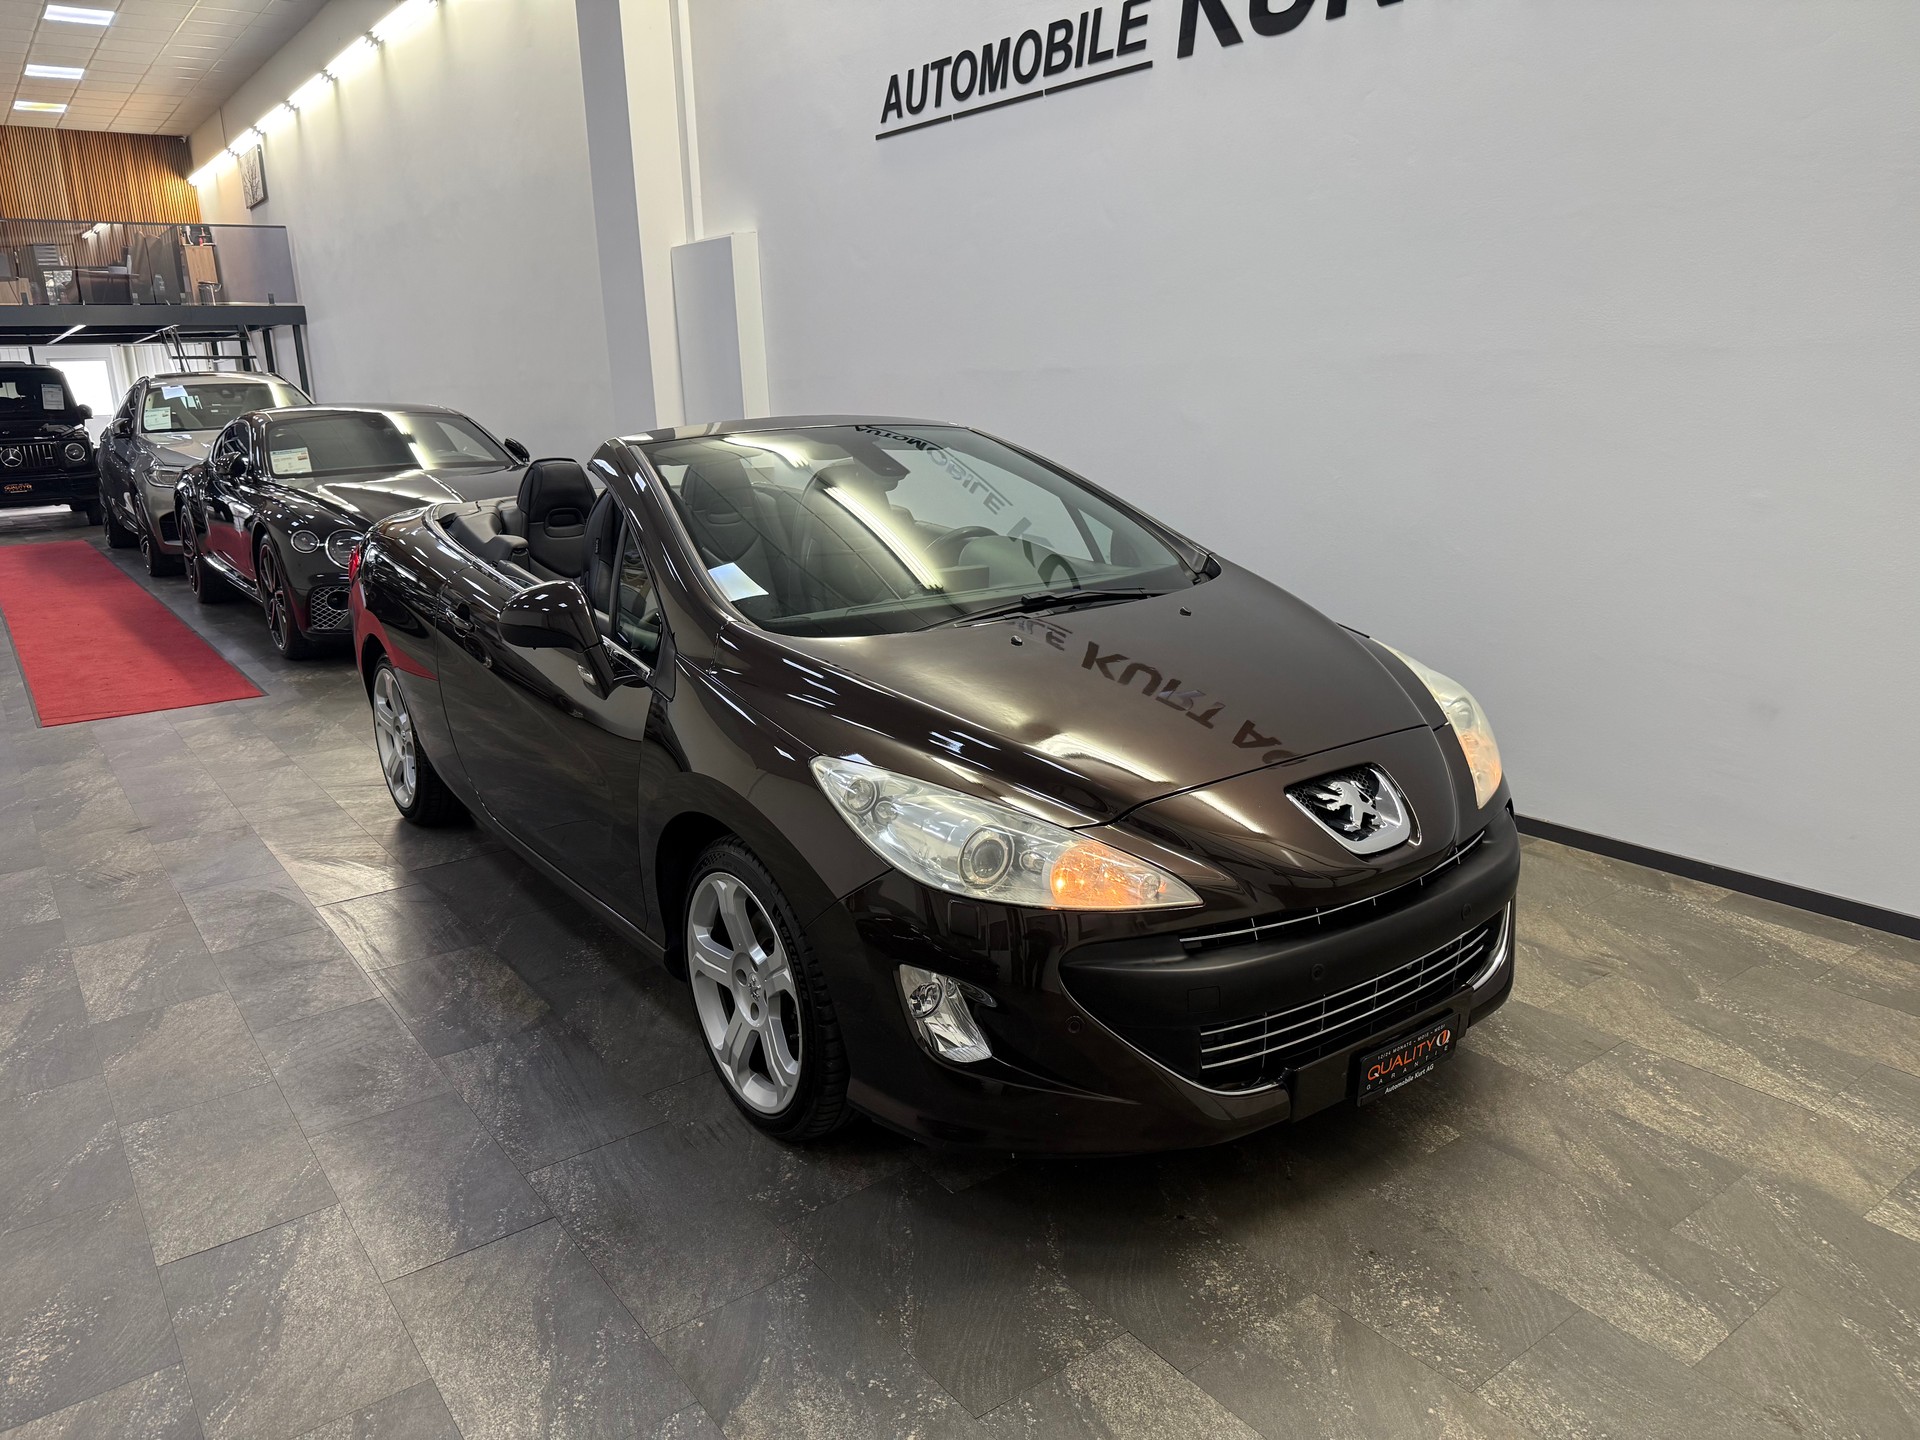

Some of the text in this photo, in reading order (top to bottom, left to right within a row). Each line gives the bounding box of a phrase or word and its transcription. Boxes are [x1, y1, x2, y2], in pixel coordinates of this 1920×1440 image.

[881, 0, 1151, 123] AUTOMOBILE
[781, 925, 809, 1000] MICHELIN
[1366, 1044, 1448, 1090] GARANTIE
[1367, 1035, 1436, 1081] QUALITY
[1384, 1063, 1435, 1094] Automobile Kurt AG
